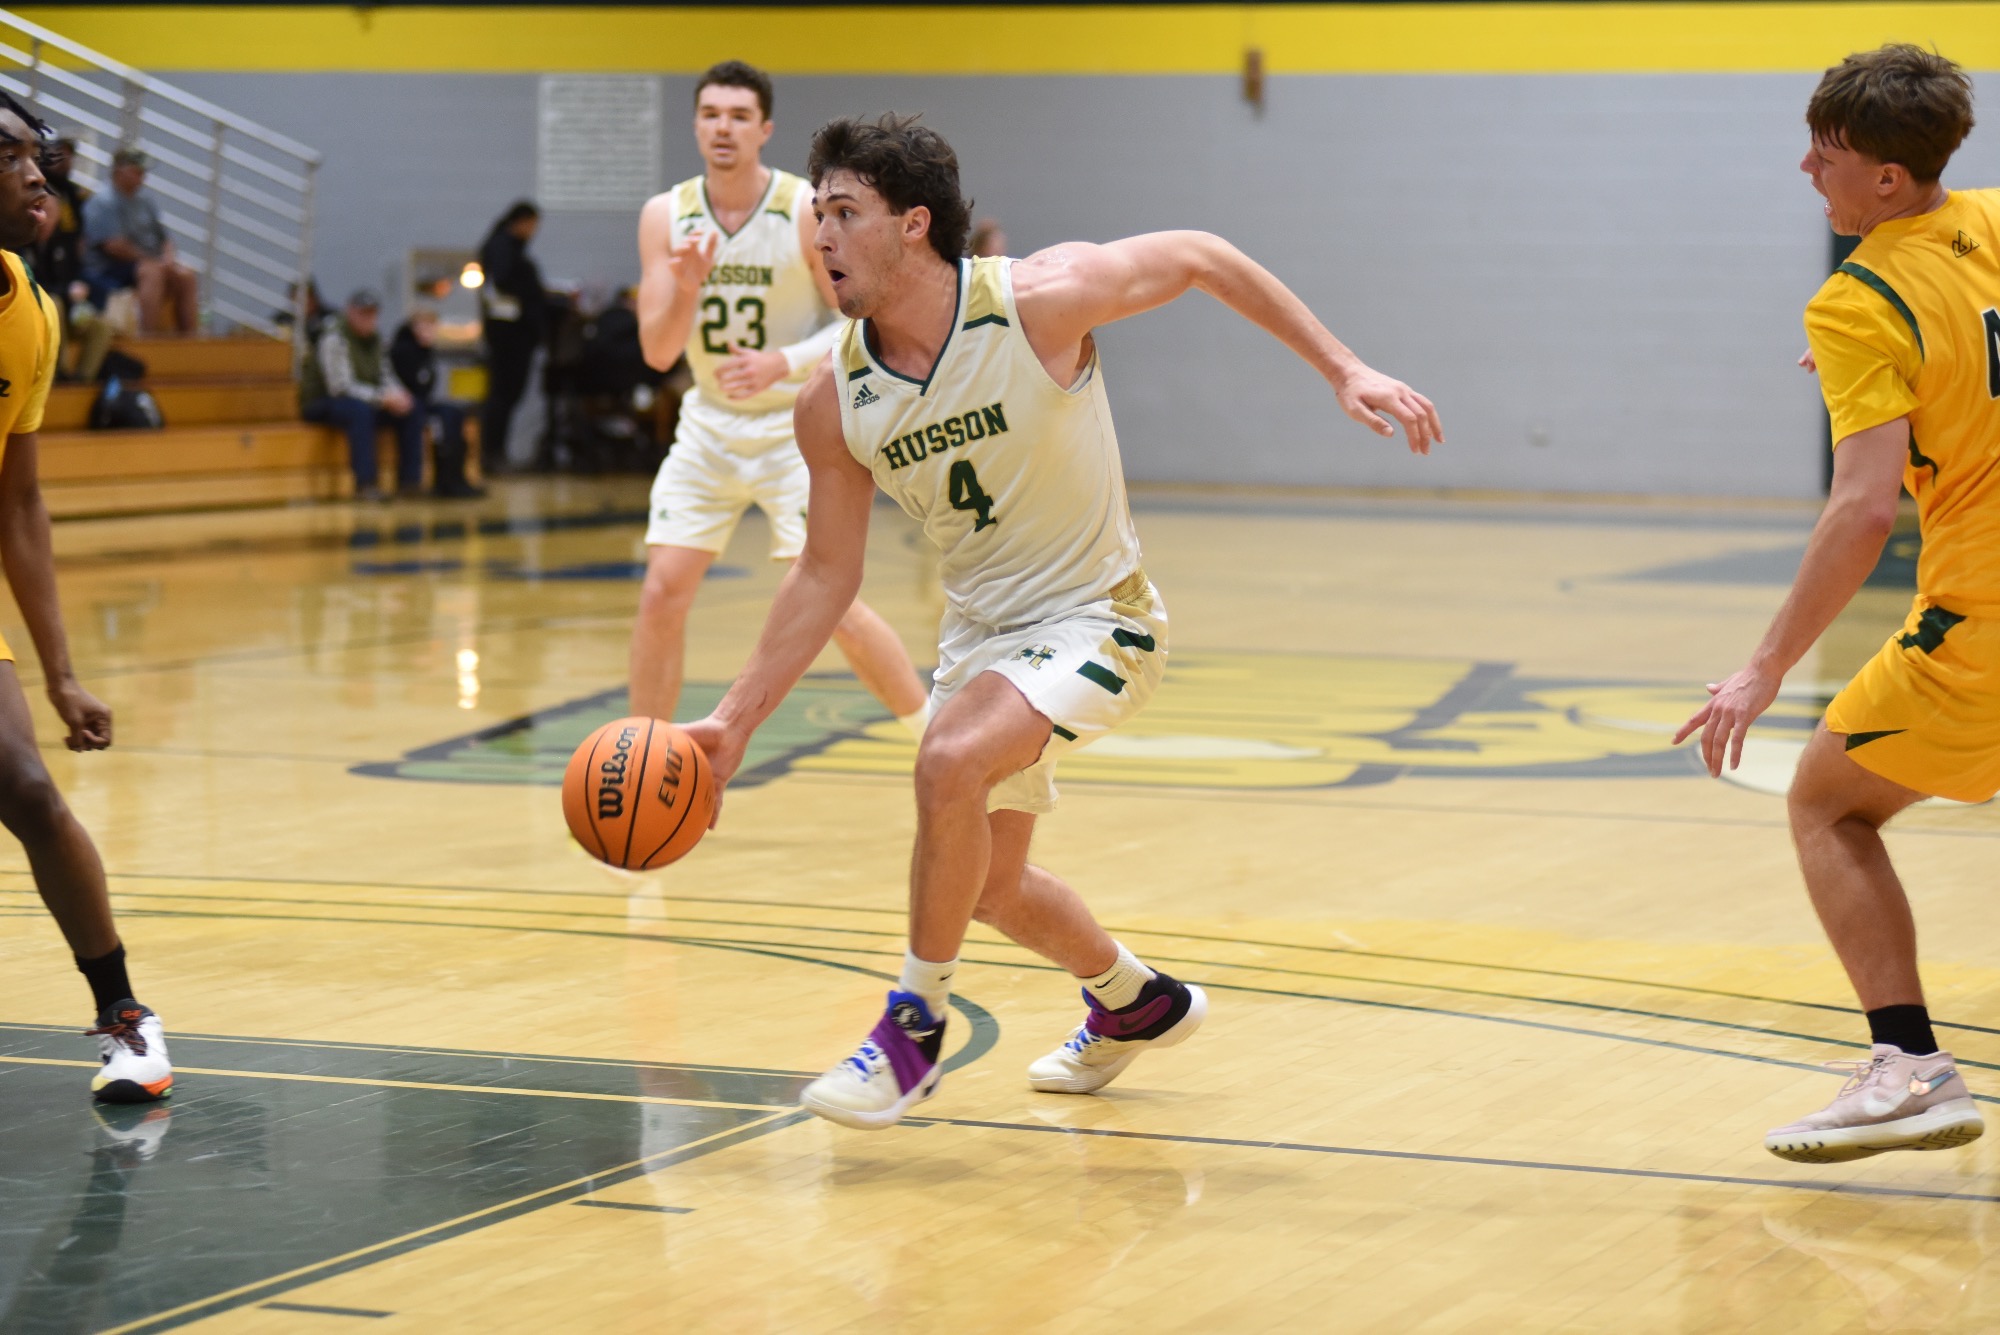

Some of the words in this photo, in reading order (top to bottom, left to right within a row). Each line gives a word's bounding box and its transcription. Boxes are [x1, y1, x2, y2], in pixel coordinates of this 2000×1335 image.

[700, 264, 774, 287] USSON
[701, 295, 767, 354] 23
[853, 393, 880, 409] adidas
[881, 402, 1009, 471] HUSSON
[949, 459, 997, 533] 4
[598, 726, 640, 820] Wilson
